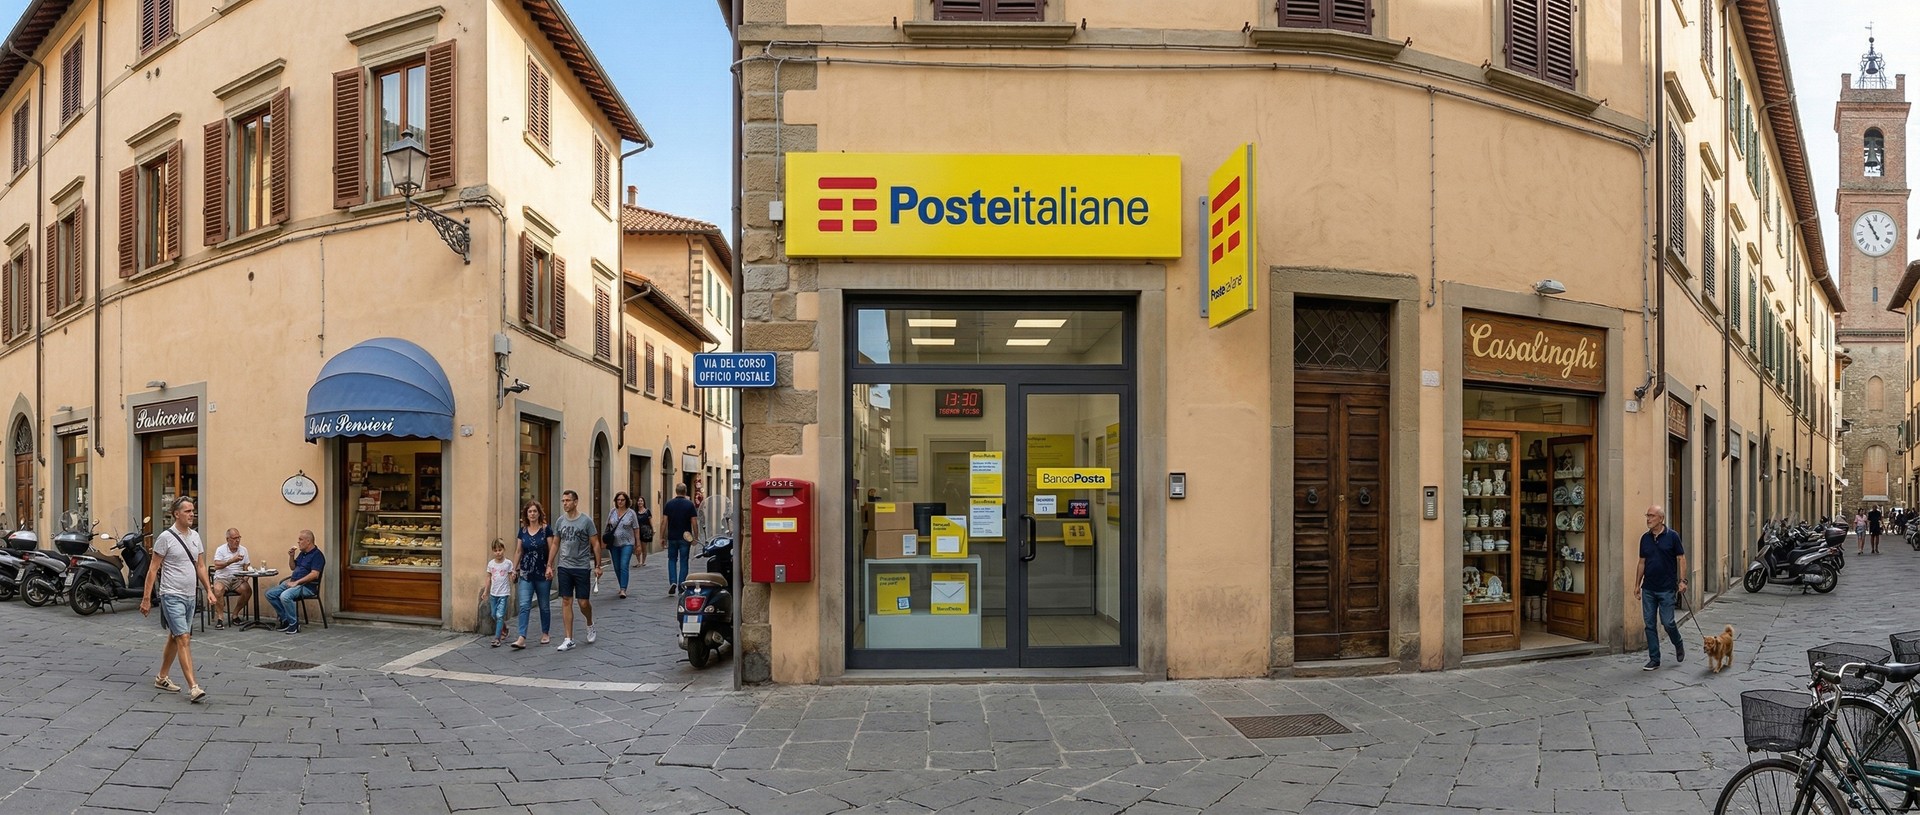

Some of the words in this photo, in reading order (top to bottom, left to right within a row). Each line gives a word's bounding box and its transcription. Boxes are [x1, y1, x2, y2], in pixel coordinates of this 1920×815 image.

[890, 186, 1149, 225] Posteitaliane
[1470, 323, 1598, 379] Casalinghi
[703, 358, 718, 369] VIA
[720, 358, 736, 369] DEL
[738, 358, 767, 369] CORSO
[699, 371, 732, 382] OFFICIO
[734, 371, 771, 382] POSTALE
[945, 392, 978, 406] 13:30
[136, 407, 196, 429] Pasticceria
[335, 413, 395, 433] Pensieri
[1043, 473, 1105, 484] BancoPosta
